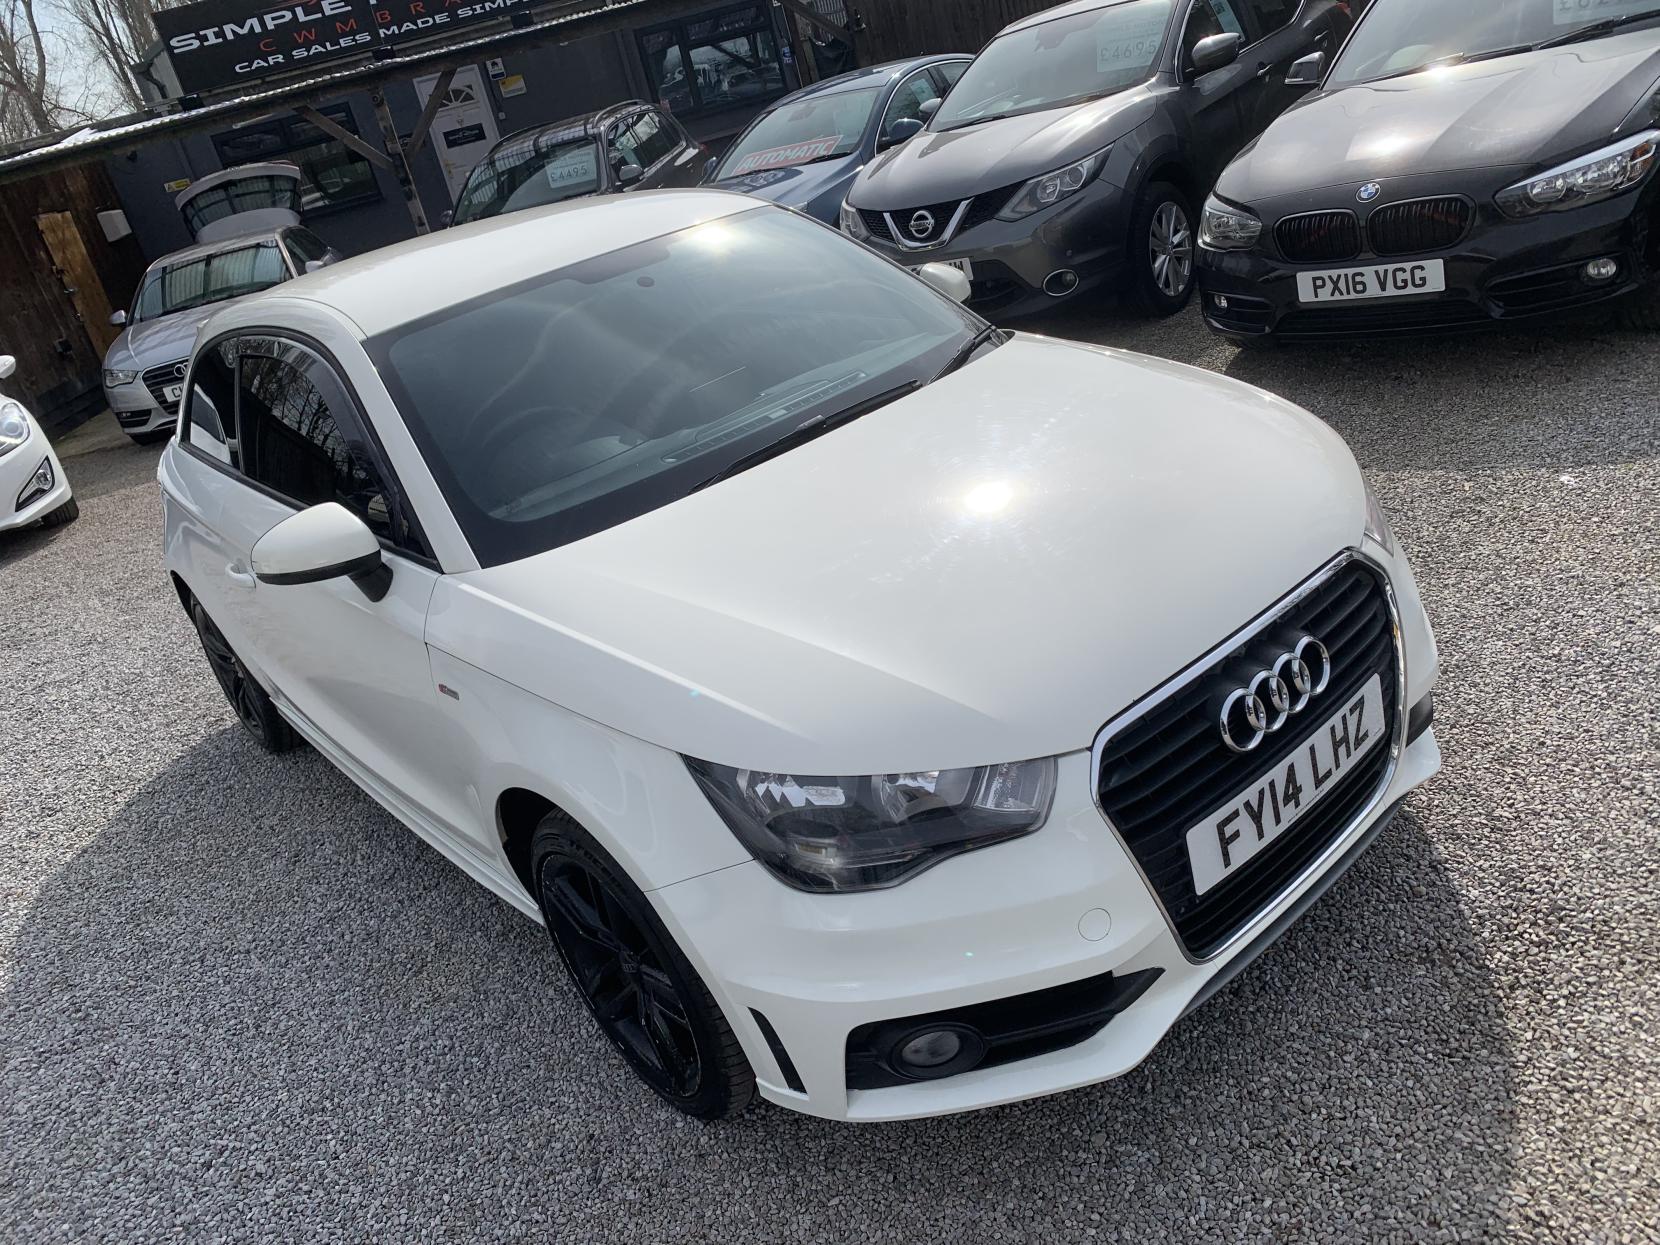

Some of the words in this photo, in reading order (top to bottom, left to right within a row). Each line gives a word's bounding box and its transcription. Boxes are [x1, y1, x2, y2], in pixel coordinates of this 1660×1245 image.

[169, 0, 352, 53] SIMPLE
[235, 54, 285, 73] CAR
[291, 32, 372, 60] SALES
[379, 12, 451, 38] MADE
[738, 140, 835, 170] AUTOMATIC
[1312, 271, 1367, 299] PX16
[1374, 264, 1427, 292] VGG
[1216, 762, 1303, 870] FY14
[1309, 694, 1369, 791] LHZ
